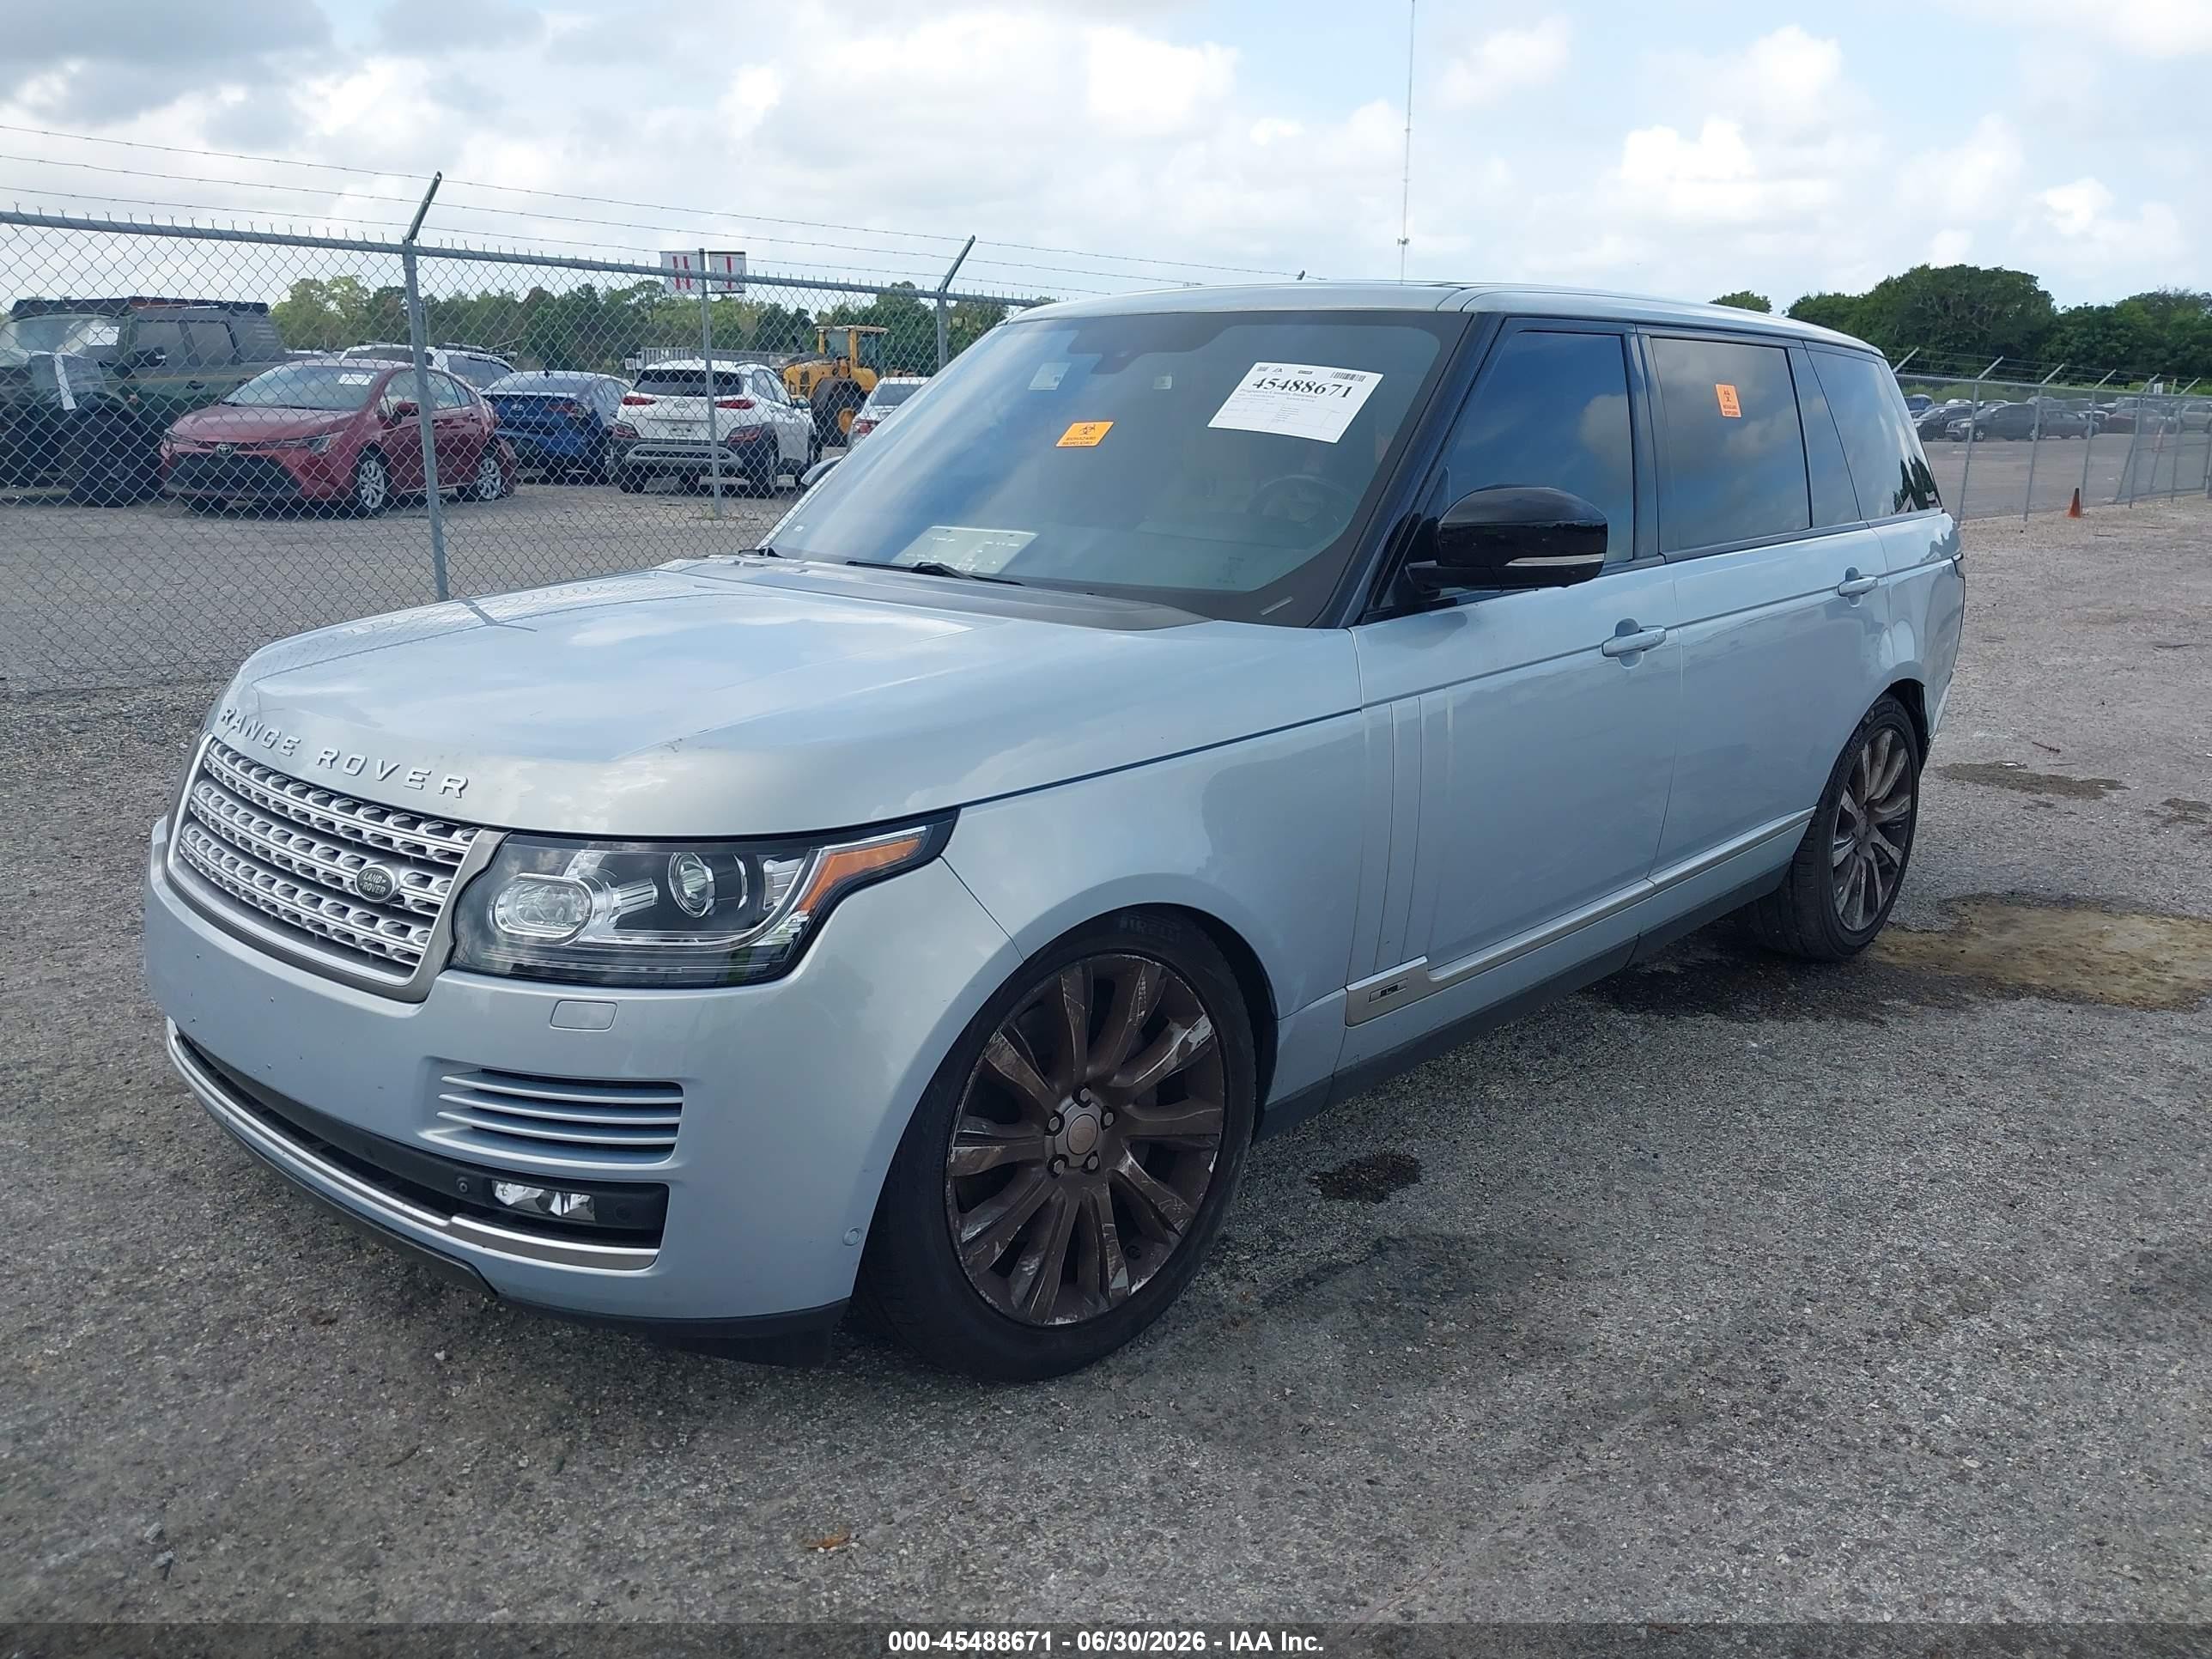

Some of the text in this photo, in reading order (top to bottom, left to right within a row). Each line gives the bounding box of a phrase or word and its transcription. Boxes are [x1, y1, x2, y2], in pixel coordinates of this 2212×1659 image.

[1251, 377, 1354, 398] 45488671
[220, 707, 469, 799] RANGE ROVER
[362, 872, 383, 884] LAND
[362, 881, 386, 896] ROVER
